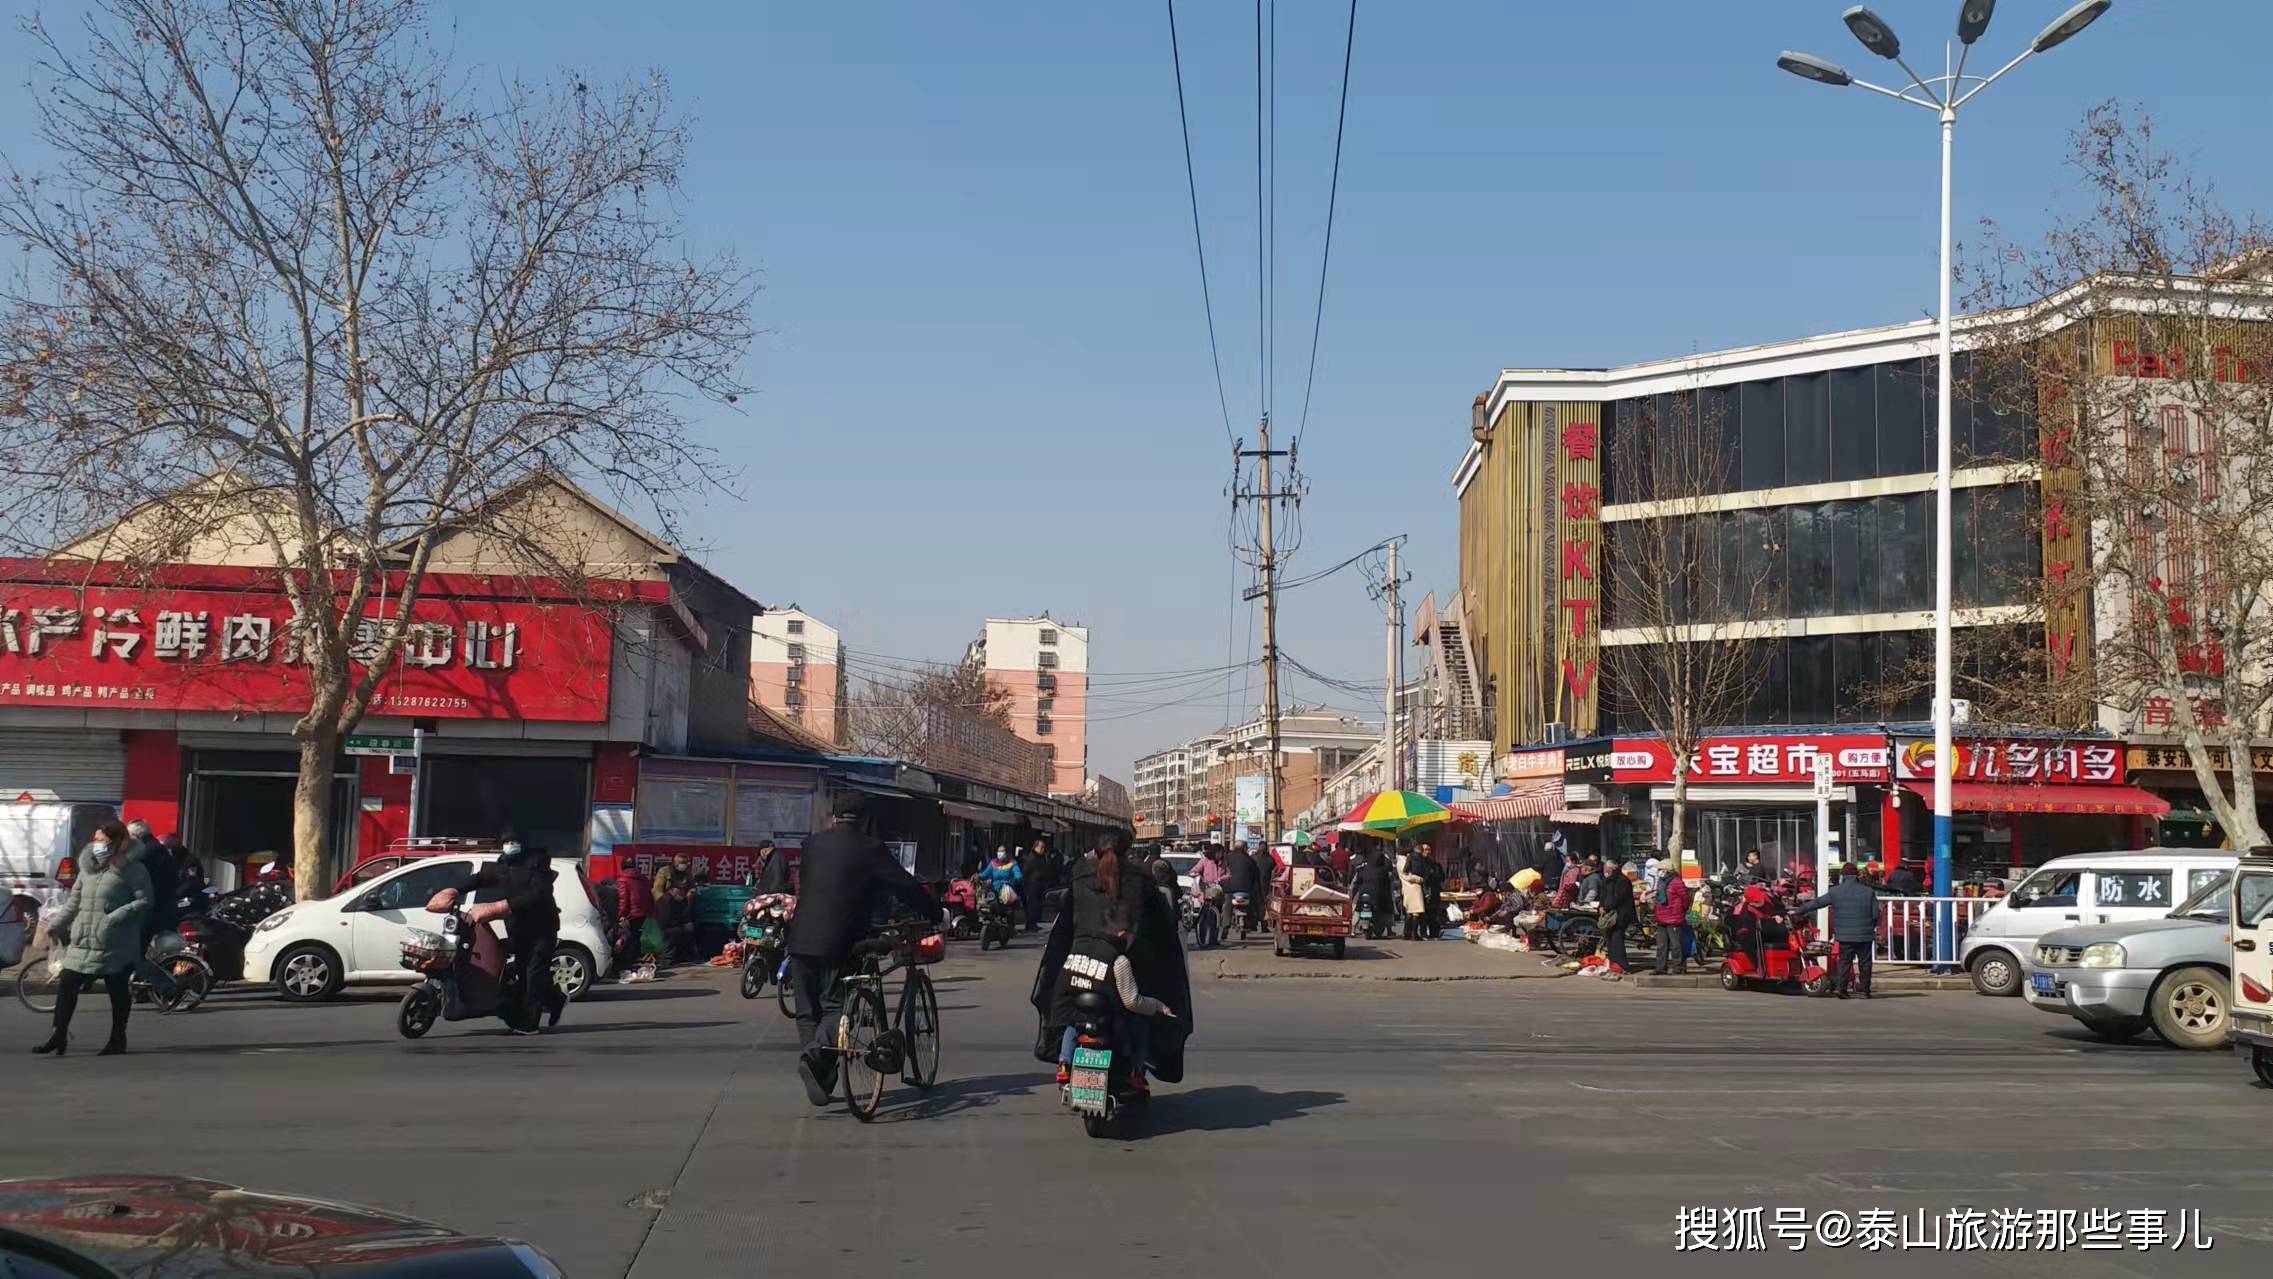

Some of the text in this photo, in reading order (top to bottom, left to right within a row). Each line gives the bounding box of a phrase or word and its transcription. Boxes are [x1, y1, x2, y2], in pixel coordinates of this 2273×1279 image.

[1562, 422, 1599, 698] 餐饮KTV
[1566, 754, 1595, 772] RELX
[1616, 755, 1647, 766] 放心购
[1847, 752, 1882, 764] 购方便
[2101, 876, 2162, 901] 防水
[1071, 976, 1092, 990] CHINA
